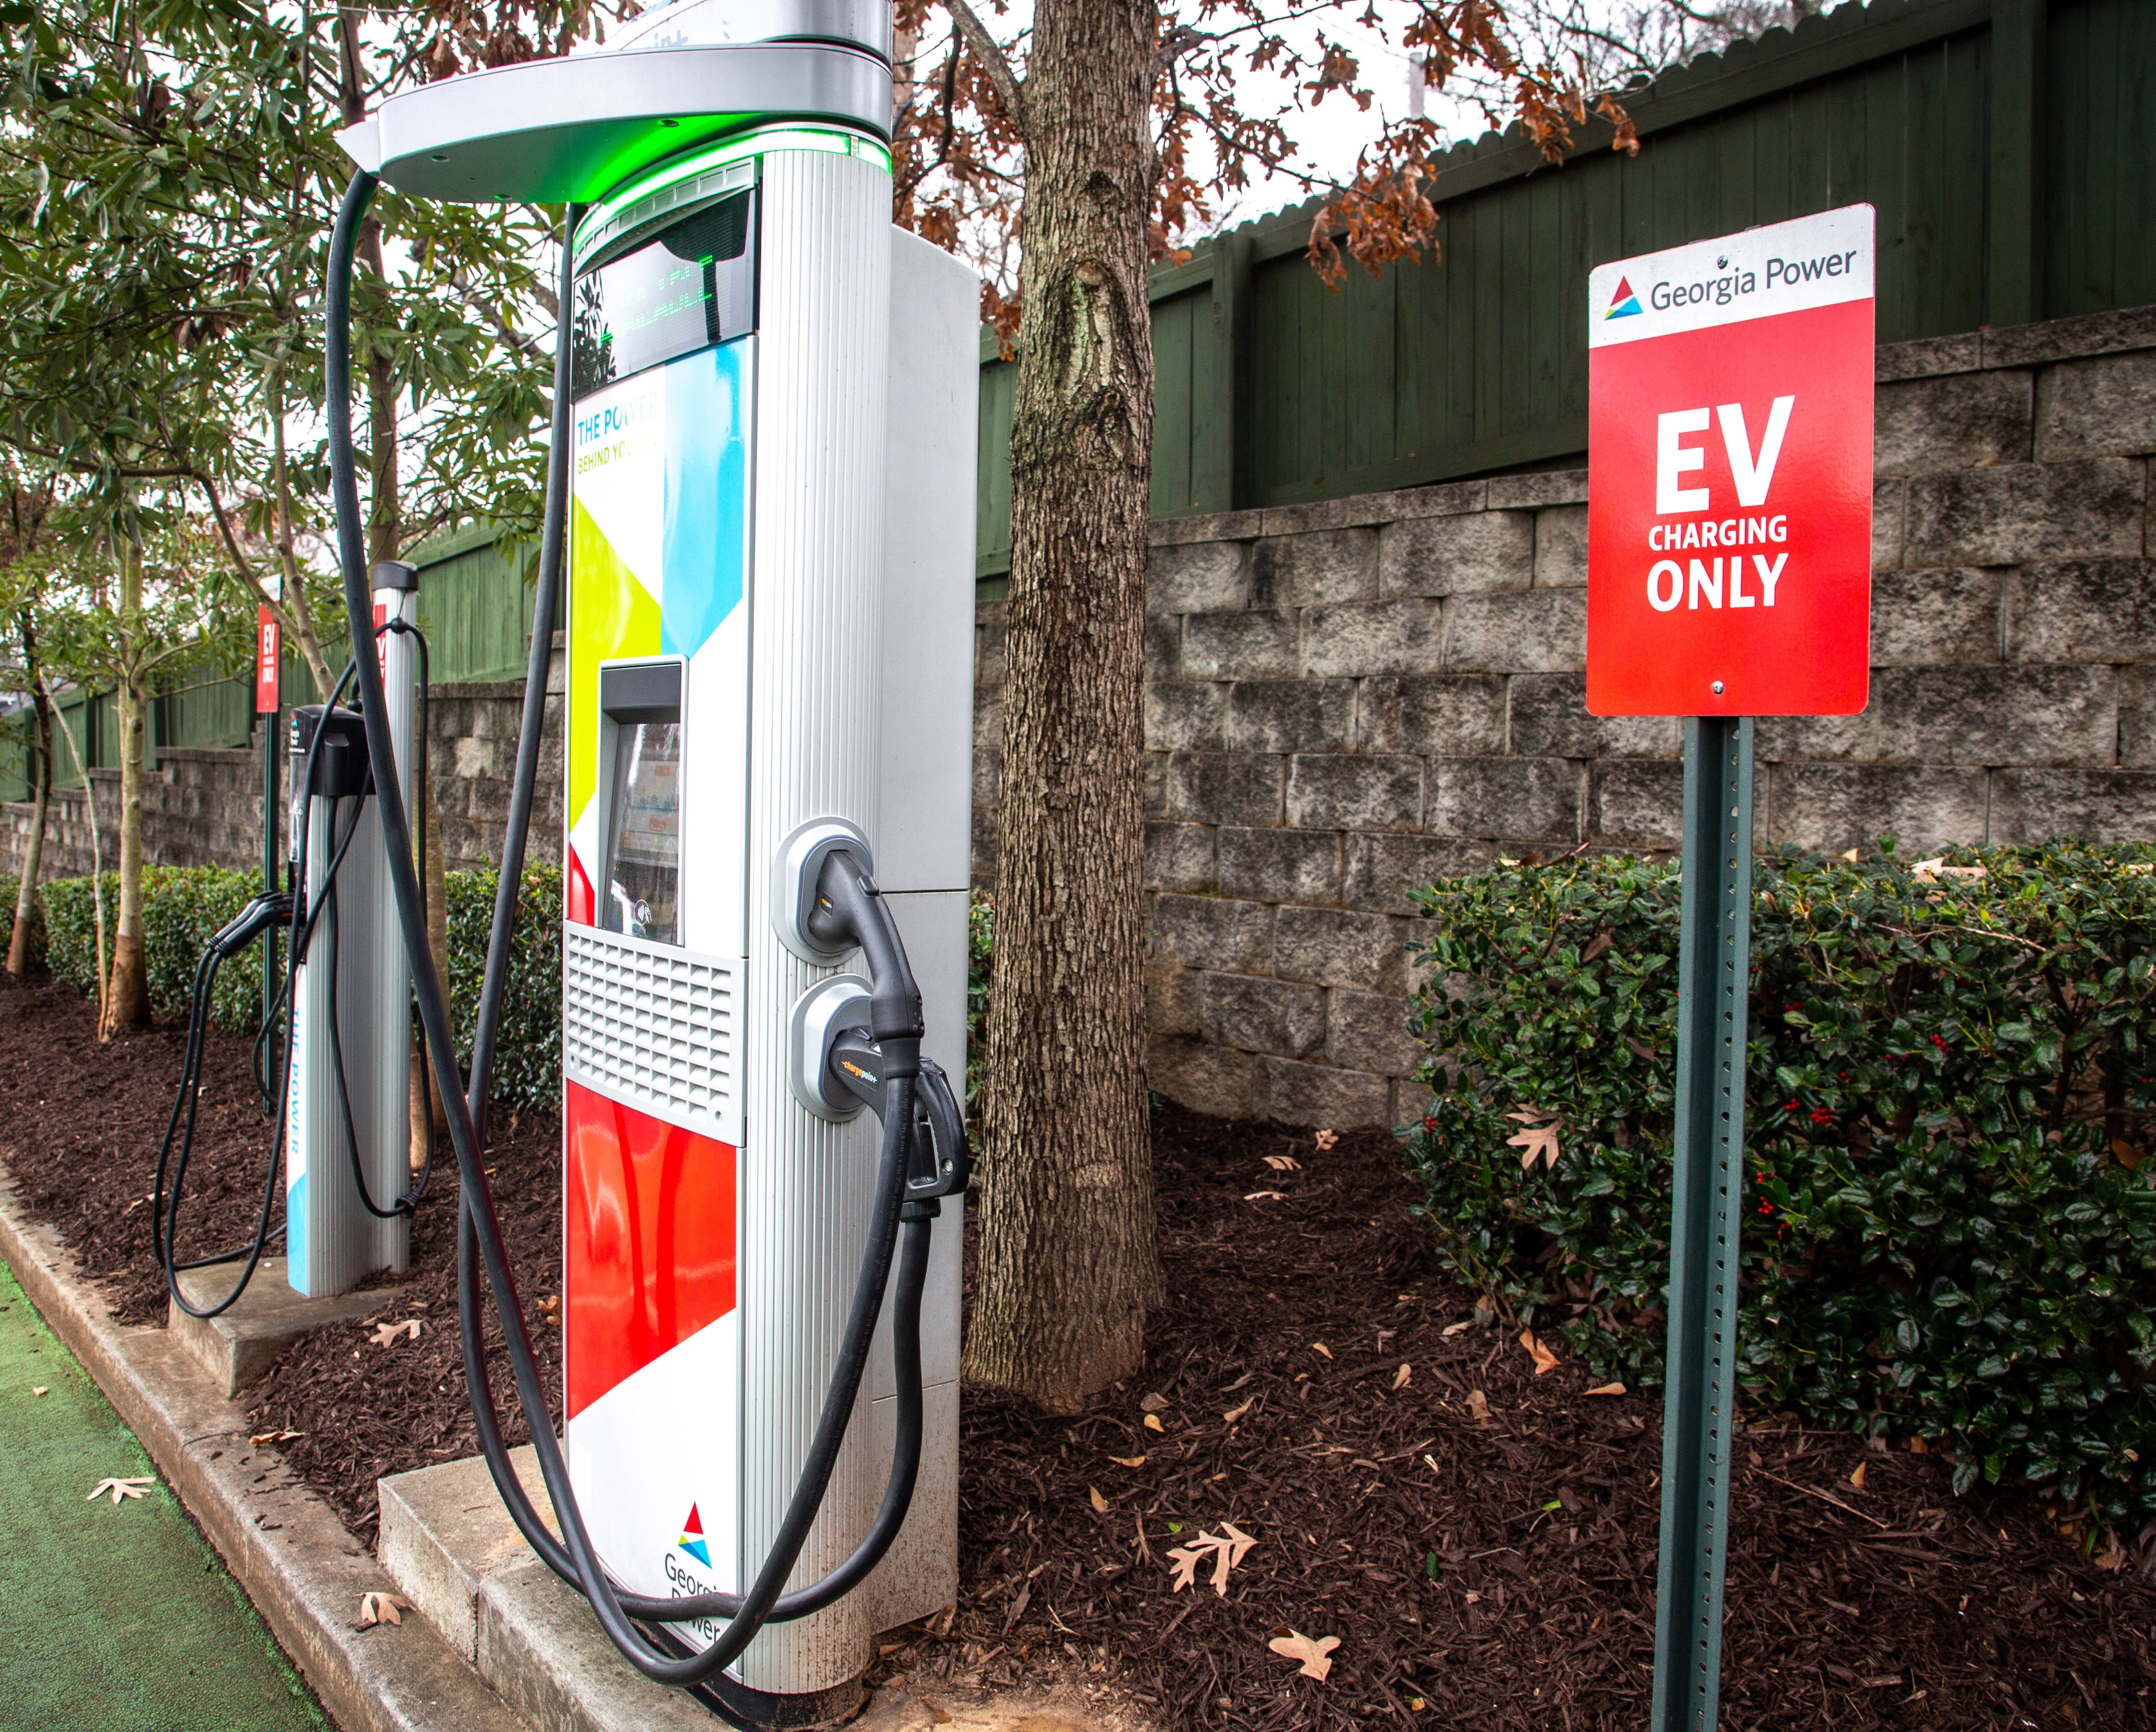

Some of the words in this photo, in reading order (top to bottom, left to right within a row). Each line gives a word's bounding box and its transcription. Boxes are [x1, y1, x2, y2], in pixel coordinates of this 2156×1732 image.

[1651, 268, 1756, 310] Georgia
[1766, 249, 1857, 288] Power
[578, 413, 600, 446] THE
[604, 391, 657, 435] POWER
[578, 446, 610, 475] BEHIND
[1656, 395, 1796, 515] EV
[1648, 515, 1788, 551] CHARGING
[1646, 552, 1789, 612] ONLY
[263, 623, 276, 656] EV
[842, 1061, 878, 1084] chargepoint
[291, 1062, 299, 1155] POWER
